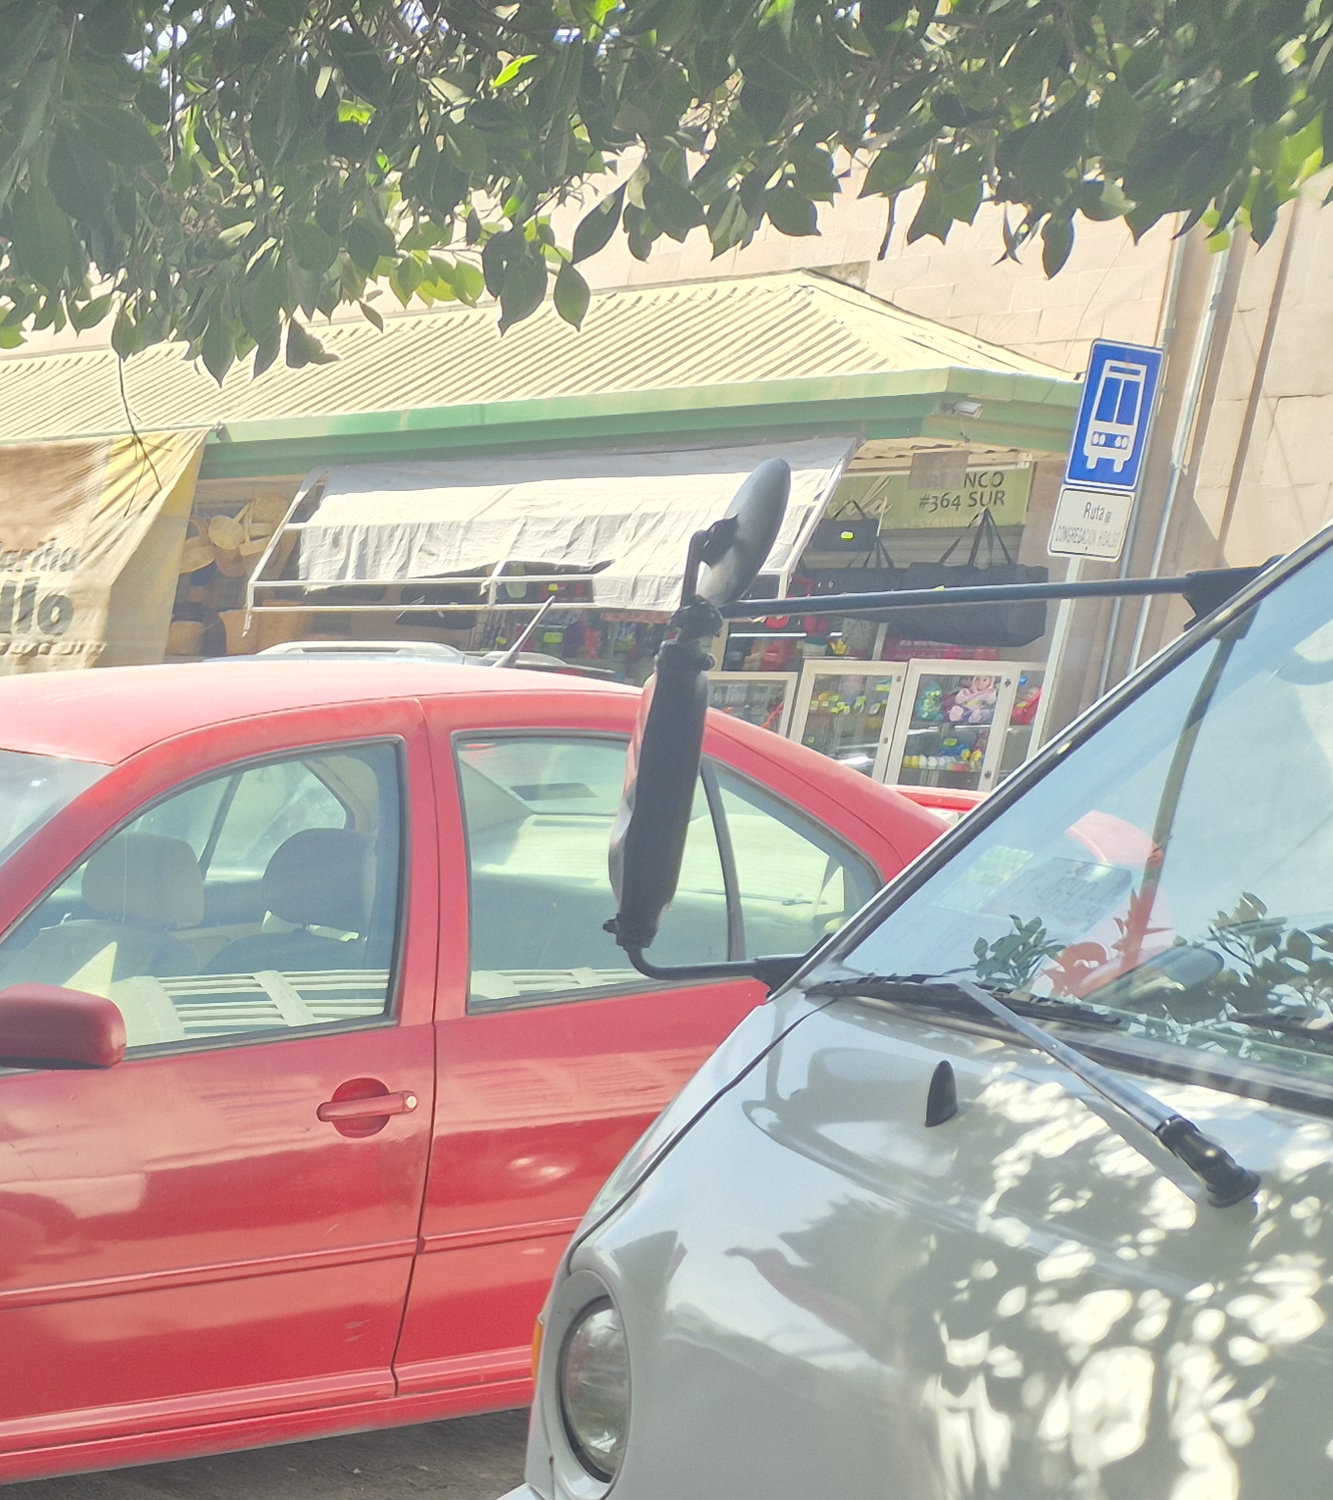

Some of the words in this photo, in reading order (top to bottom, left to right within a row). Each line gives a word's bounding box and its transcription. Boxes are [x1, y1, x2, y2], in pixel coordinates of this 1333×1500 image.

[919, 492, 962, 513] #364
[967, 490, 1007, 508] SUR
[1083, 501, 1105, 521] Ruta
